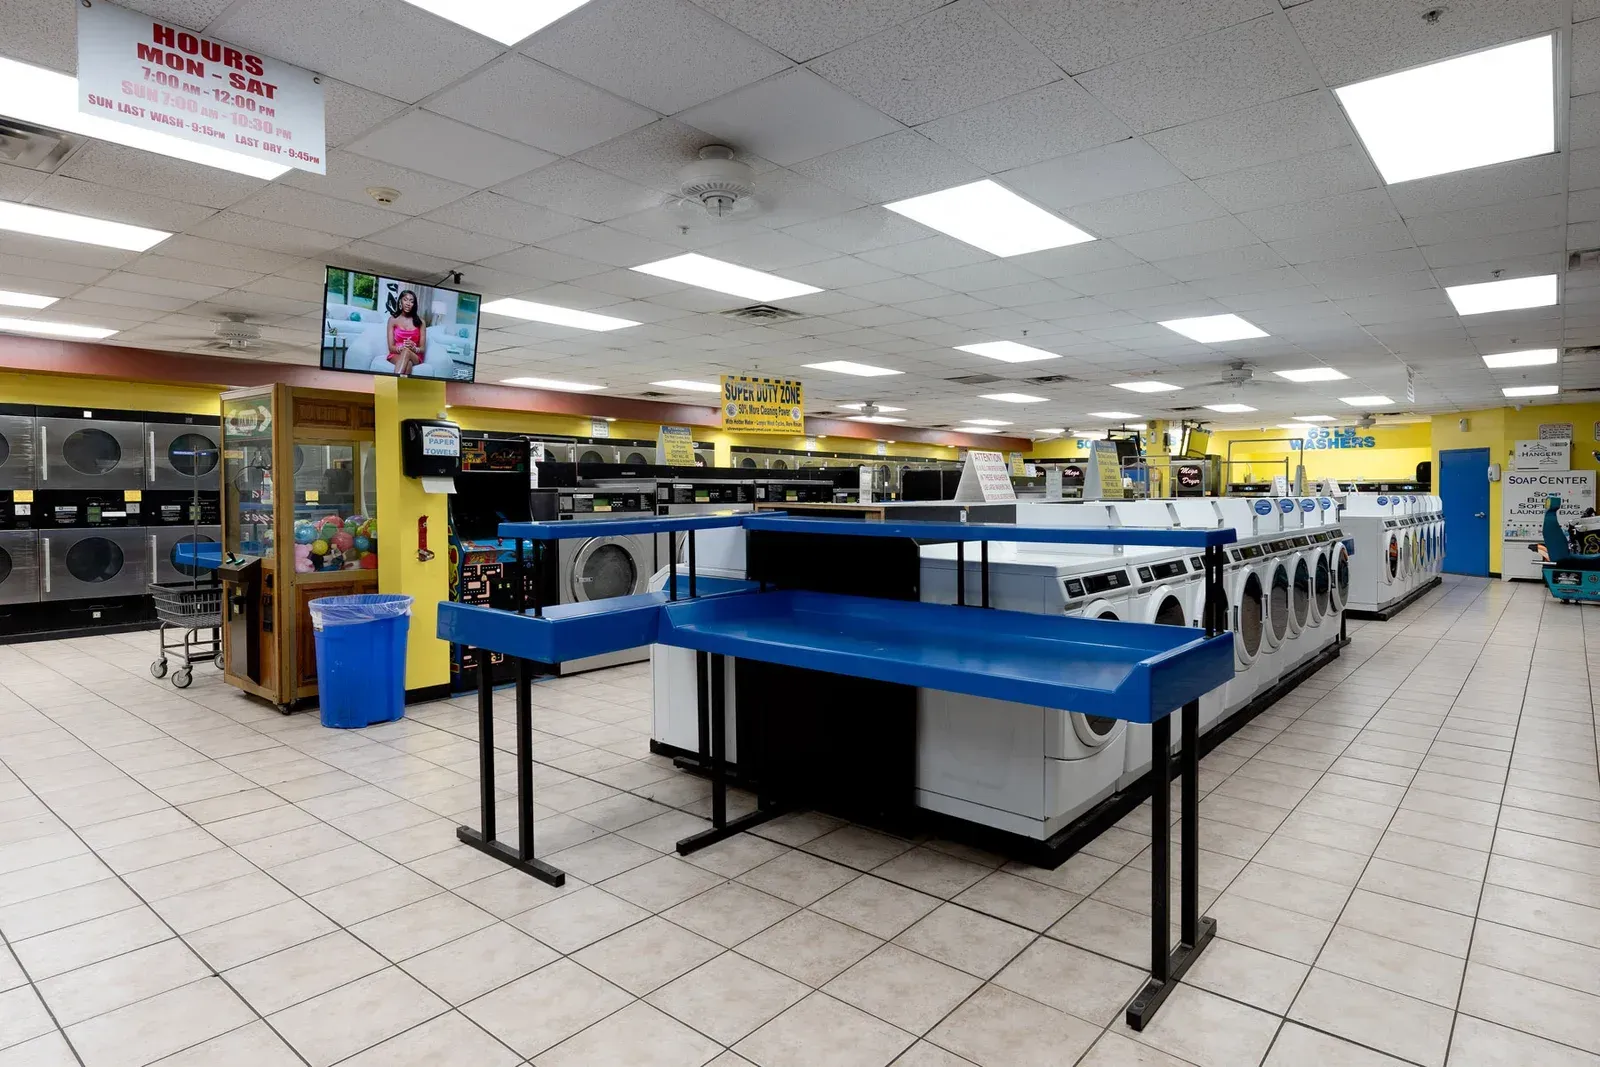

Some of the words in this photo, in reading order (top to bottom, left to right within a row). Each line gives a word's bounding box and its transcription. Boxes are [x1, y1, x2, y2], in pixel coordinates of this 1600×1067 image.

[153, 23, 264, 76] HOURS
[137, 43, 204, 78] MON
[229, 72, 277, 99] SAT
[142, 66, 179, 89] 7:00
[183, 82, 200, 96] AM
[212, 89, 256, 111] 12:00
[259, 105, 275, 117] PM
[121, 80, 158, 103] SUN
[162, 91, 197, 113] 7:00
[200, 106, 218, 119] AM
[231, 112, 273, 135] 10:30
[276, 128, 292, 140] PM
[88, 94, 113, 109] SUN
[118, 102, 146, 118] LAST
[150, 111, 184, 128] WASH
[235, 134, 259, 148] LAST
[263, 142, 282, 154] DRY
[725, 382, 755, 401] SUPER
[757, 383, 778, 403] DUTY
[780, 385, 801, 405] ZONE
[738, 403, 748, 415] 50%
[749, 404, 760, 415] More
[760, 405, 778, 418] Cleaning
[779, 406, 791, 417] Power
[1308, 427, 1330, 439] 65
[1334, 426, 1356, 438] LB
[428, 438, 455, 446] PAPER
[1289, 436, 1376, 450] WASHERS
[425, 448, 458, 456] TOWELS
[974, 452, 1002, 462] ATTENTION
[1064, 468, 1080, 477] Mega
[1180, 467, 1198, 475] Mega
[1182, 476, 1200, 485] Dryer
[1508, 475, 1537, 484] SOAP
[1539, 475, 1588, 484] CENTER
